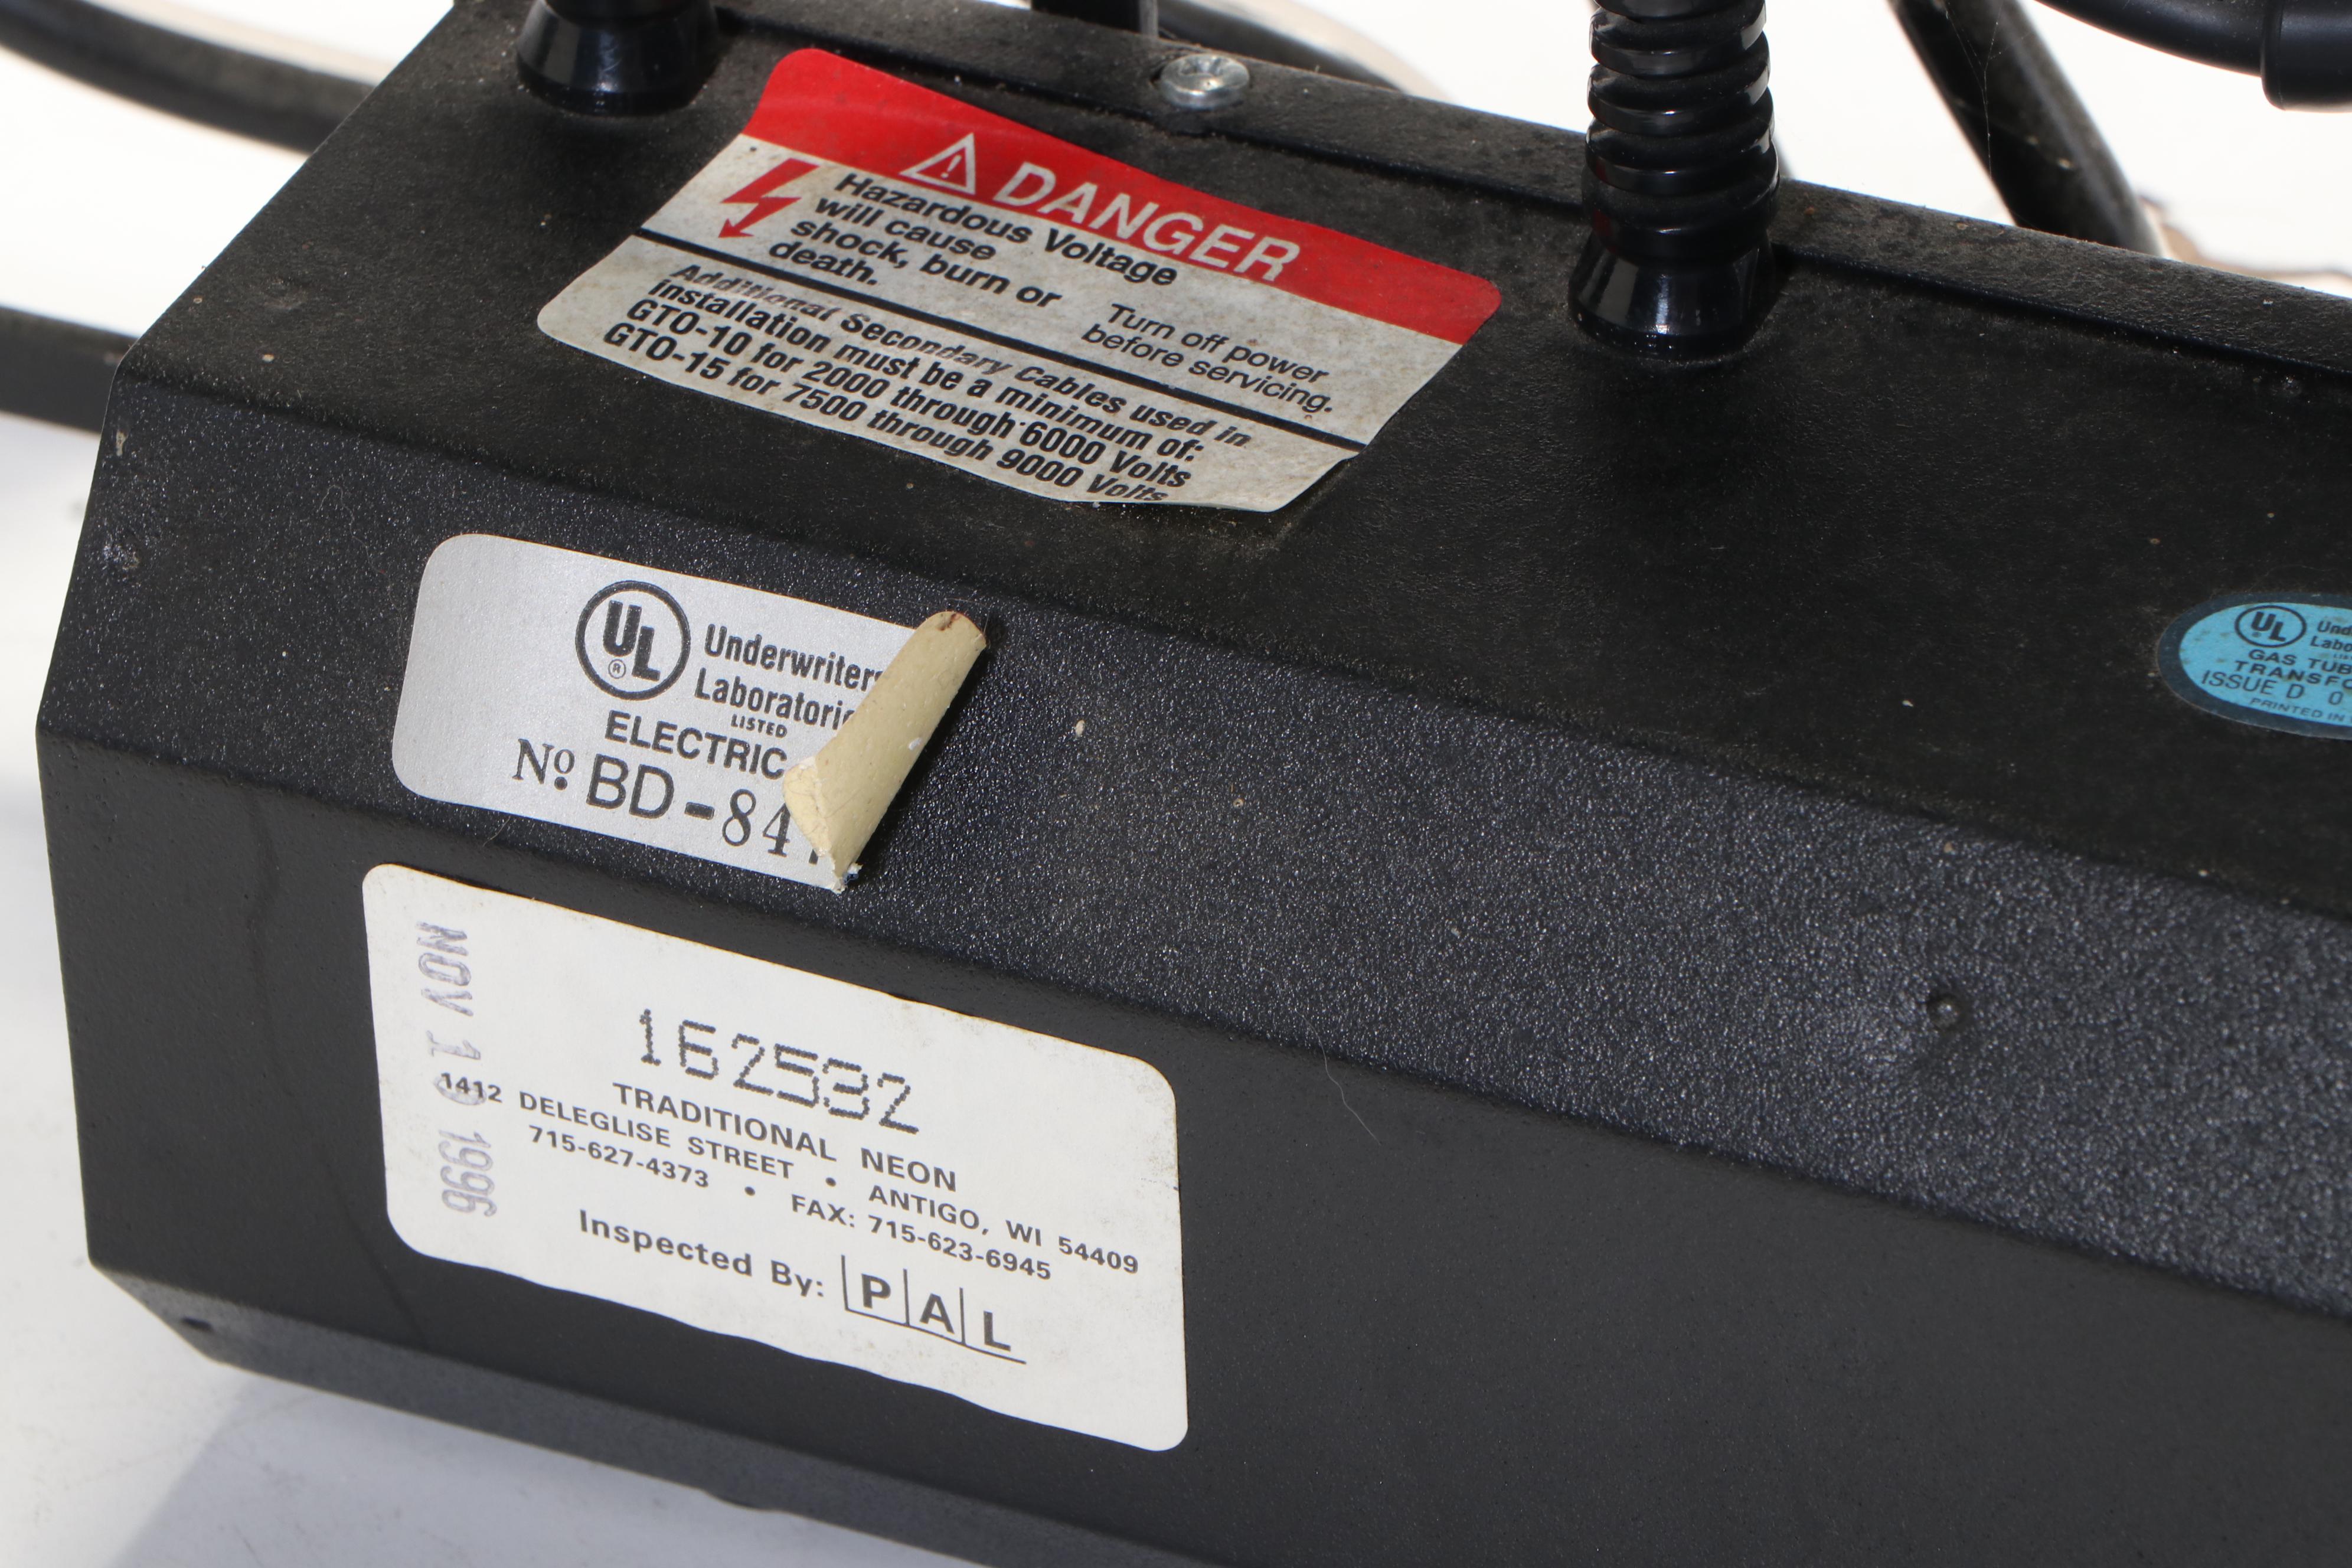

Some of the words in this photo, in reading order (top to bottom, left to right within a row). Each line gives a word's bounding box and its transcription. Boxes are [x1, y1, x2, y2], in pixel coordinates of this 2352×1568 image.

[769, 241, 877, 285] death.
[790, 220, 909, 269] shock,
[919, 253, 1011, 294] burn
[1015, 286, 1062, 307] or
[815, 198, 884, 227] will
[884, 220, 996, 260] cause
[834, 173, 1033, 243] Hazardous
[1044, 227, 1178, 285] Voltage
[993, 161, 1301, 282] DANGER
[648, 279, 832, 352] installation
[833, 344, 920, 380] must
[919, 361, 964, 390] be
[967, 378, 992, 398] a
[995, 387, 1152, 450] minimum
[1157, 438, 1204, 462] of:
[669, 264, 841, 321] Additional
[841, 313, 1012, 374] Secondary
[1015, 366, 1127, 413] Cables
[1129, 404, 1217, 436] used
[1214, 426, 1252, 447] in
[1082, 324, 1184, 367] before
[1188, 360, 1333, 413] servicing.
[1108, 303, 1175, 339] Turn
[1181, 331, 1228, 353] off
[1224, 345, 1329, 383] power
[603, 322, 731, 380] GTO-15
[727, 367, 782, 395] for
[783, 383, 867, 422] 7500
[867, 410, 994, 461] through
[997, 449, 1084, 487] 9000
[1087, 474, 1168, 501] Volts
[626, 299, 752, 356] GTO-10
[750, 342, 804, 373] for
[801, 361, 890, 398] 2000
[890, 386, 1016, 438] through
[1019, 421, 1106, 465] 6000
[1110, 450, 1191, 487] Volts
[602, 600, 661, 681] UL
[2201, 669, 2277, 695] ISSUE
[2248, 649, 2297, 666] GAS
[605, 710, 787, 780] ELECTRIC
[730, 714, 788, 738] LISTED
[2249, 697, 2322, 718] PRINTED
[2328, 713, 2344, 722] IN
[586, 753, 819, 865] BD-84
[416, 922, 473, 1017] NOV
[639, 1007, 920, 1135] 162532
[438, 1129, 497, 1217] 1996
[441, 1072, 502, 1103] 1412
[519, 1091, 671, 1147] DELEGLISE
[688, 1136, 794, 1179] STREET
[869, 1185, 989, 1236] ANTIGO,
[1005, 1220, 1042, 1246] WI
[1059, 1236, 1139, 1275] 54409
[612, 1082, 837, 1162] TRADITIONAL
[861, 1147, 957, 1192] NEON
[529, 1125, 709, 1188] 715-627-4373
[791, 1194, 855, 1228] FAX:
[868, 1215, 1051, 1280] 715-623-6945
[579, 1210, 753, 1276] Inspected
[771, 1259, 824, 1297] By:
